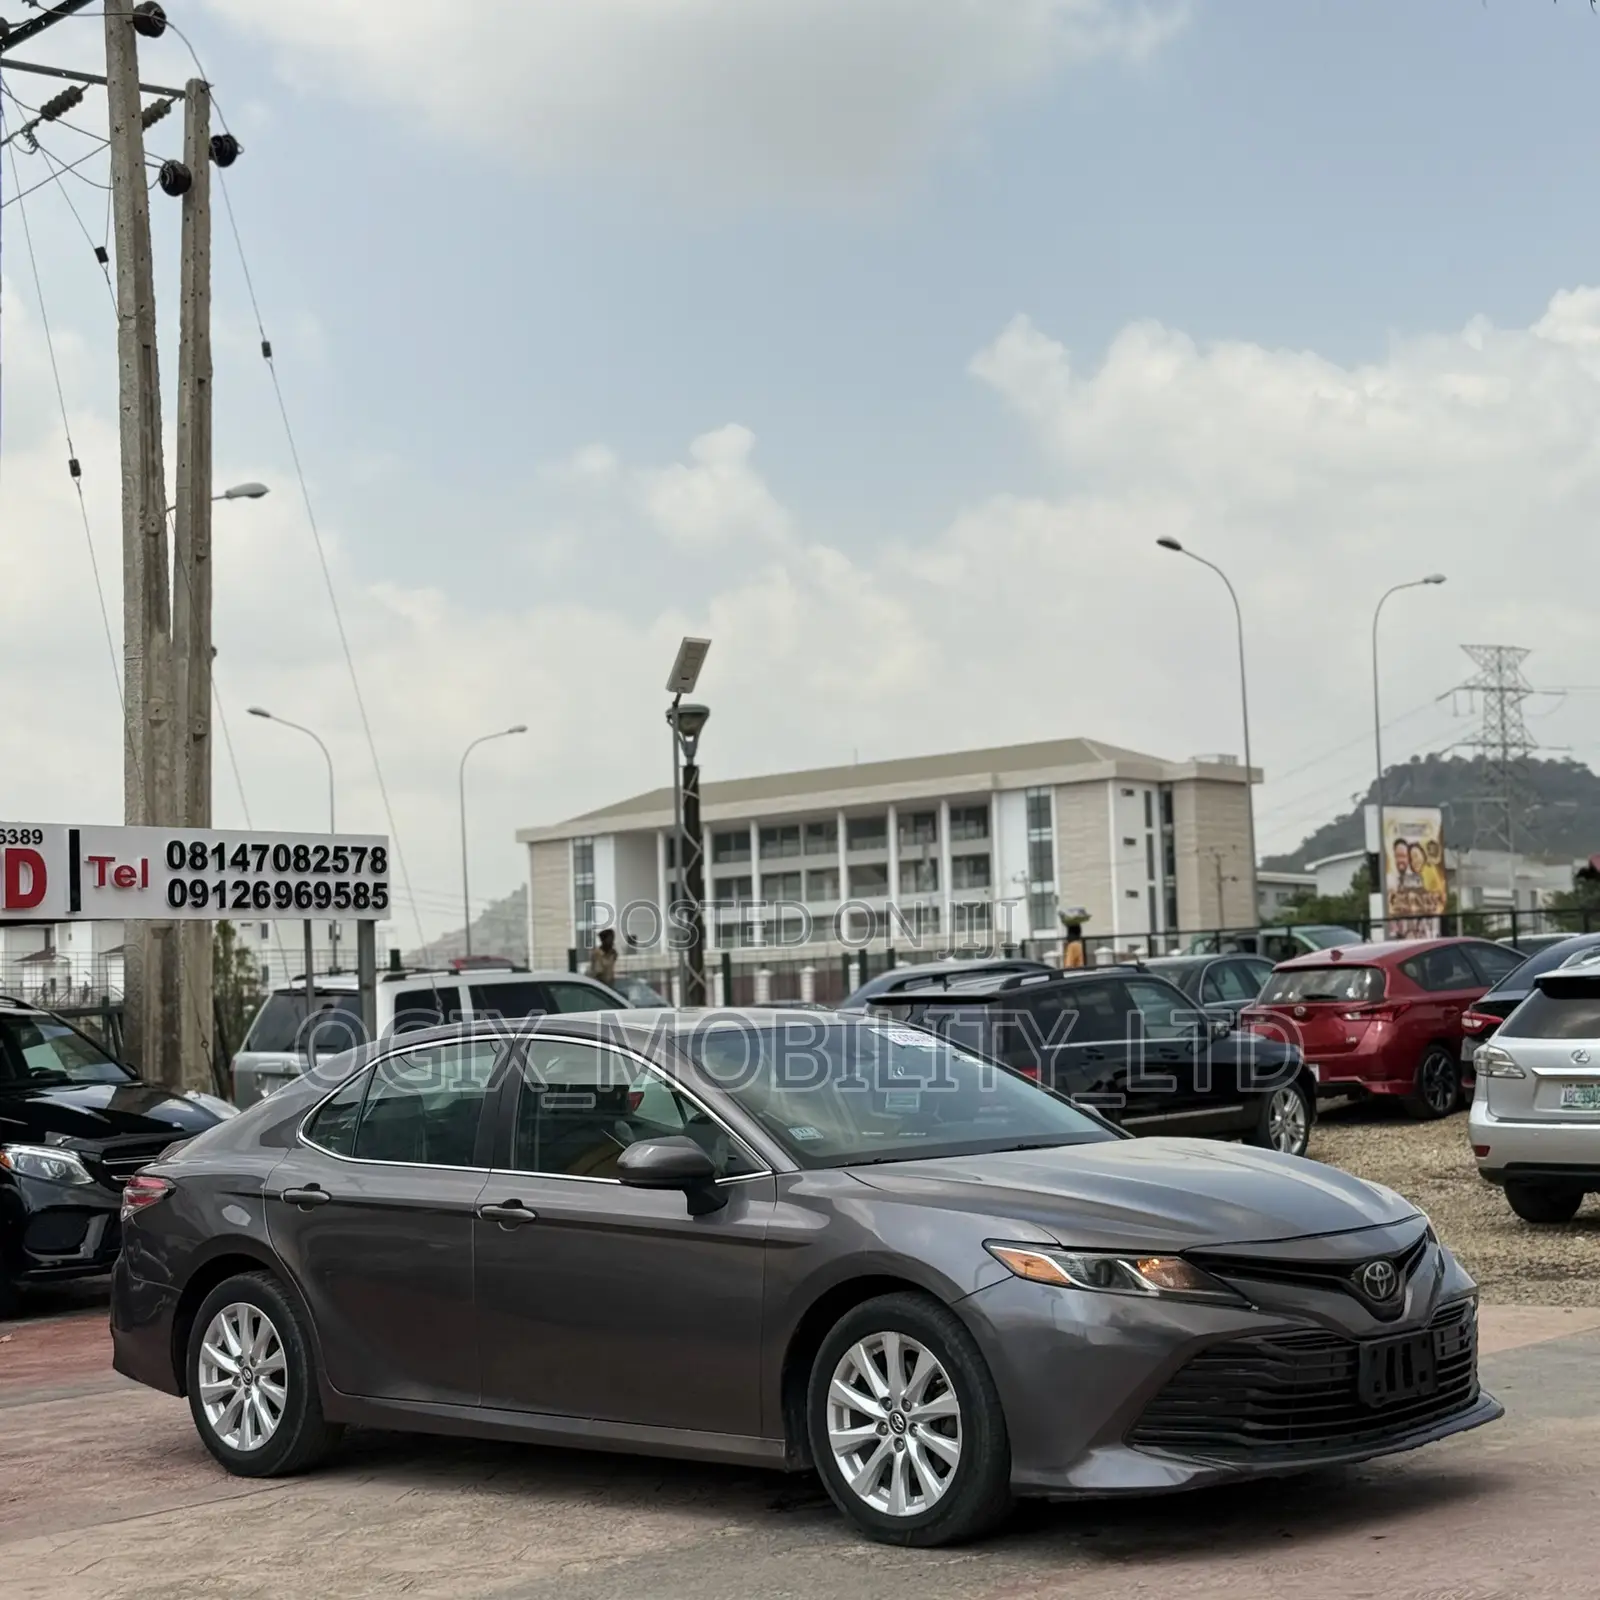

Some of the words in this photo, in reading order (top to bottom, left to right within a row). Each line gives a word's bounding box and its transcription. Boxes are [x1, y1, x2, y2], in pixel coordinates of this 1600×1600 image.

[87, 855, 149, 889] Tel
[166, 839, 388, 874] 08147082578
[167, 878, 389, 910] 09126969585
